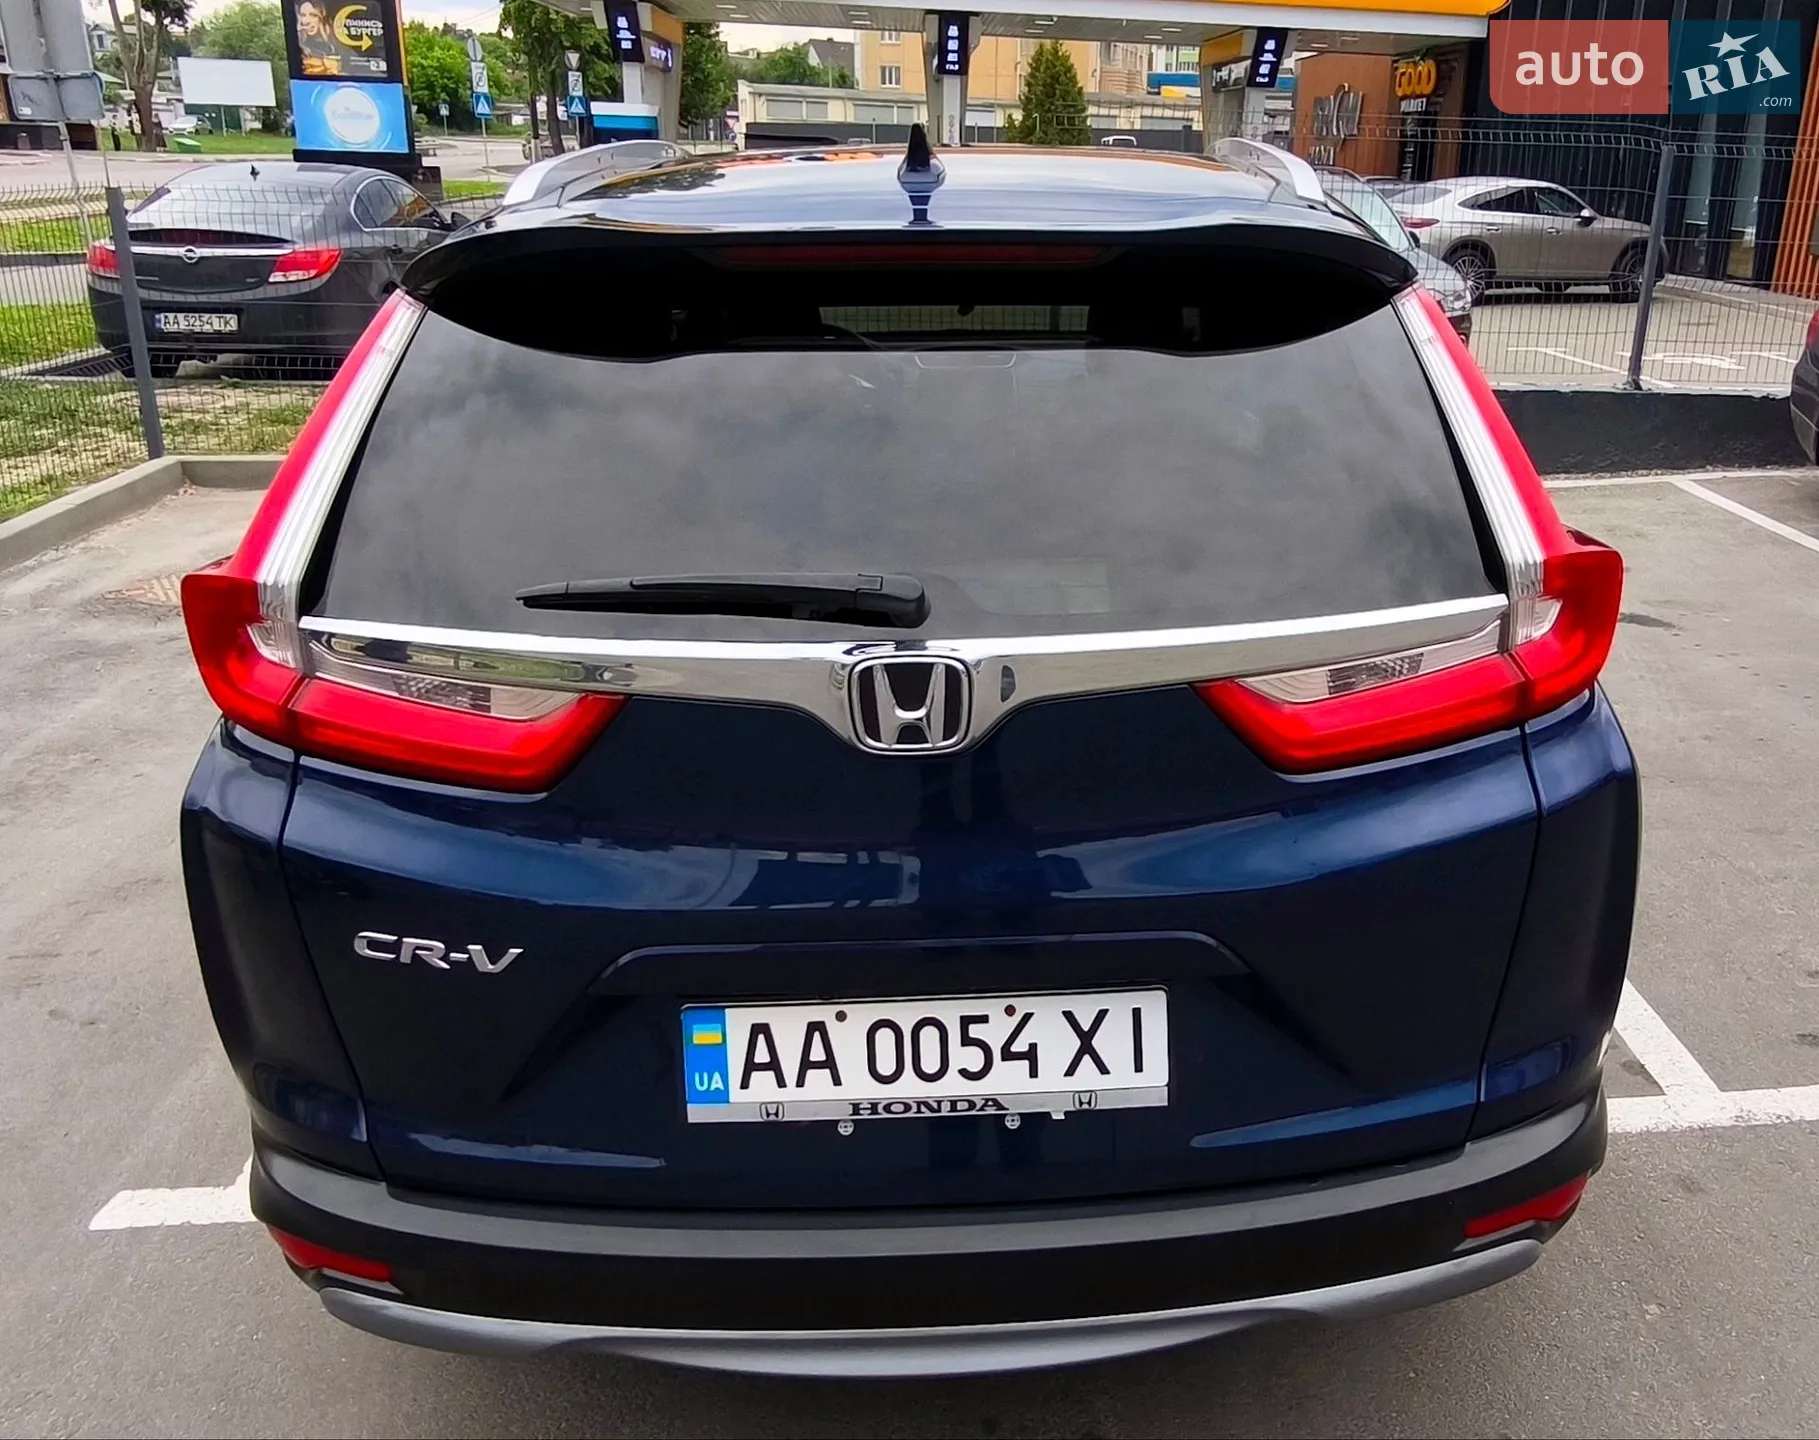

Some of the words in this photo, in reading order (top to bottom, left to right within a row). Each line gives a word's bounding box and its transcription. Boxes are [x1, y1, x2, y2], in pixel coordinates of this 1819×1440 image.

[350, 27, 384, 36] БУРГЕР
[183, 314, 213, 328] 5254
[354, 931, 524, 973] CR-V
[740, 1020, 843, 1090] AA
[866, 1012, 1039, 1085] 0054
[1063, 1007, 1144, 1078] XI
[694, 1071, 725, 1092] UA
[848, 1097, 1010, 1117] HONDA
